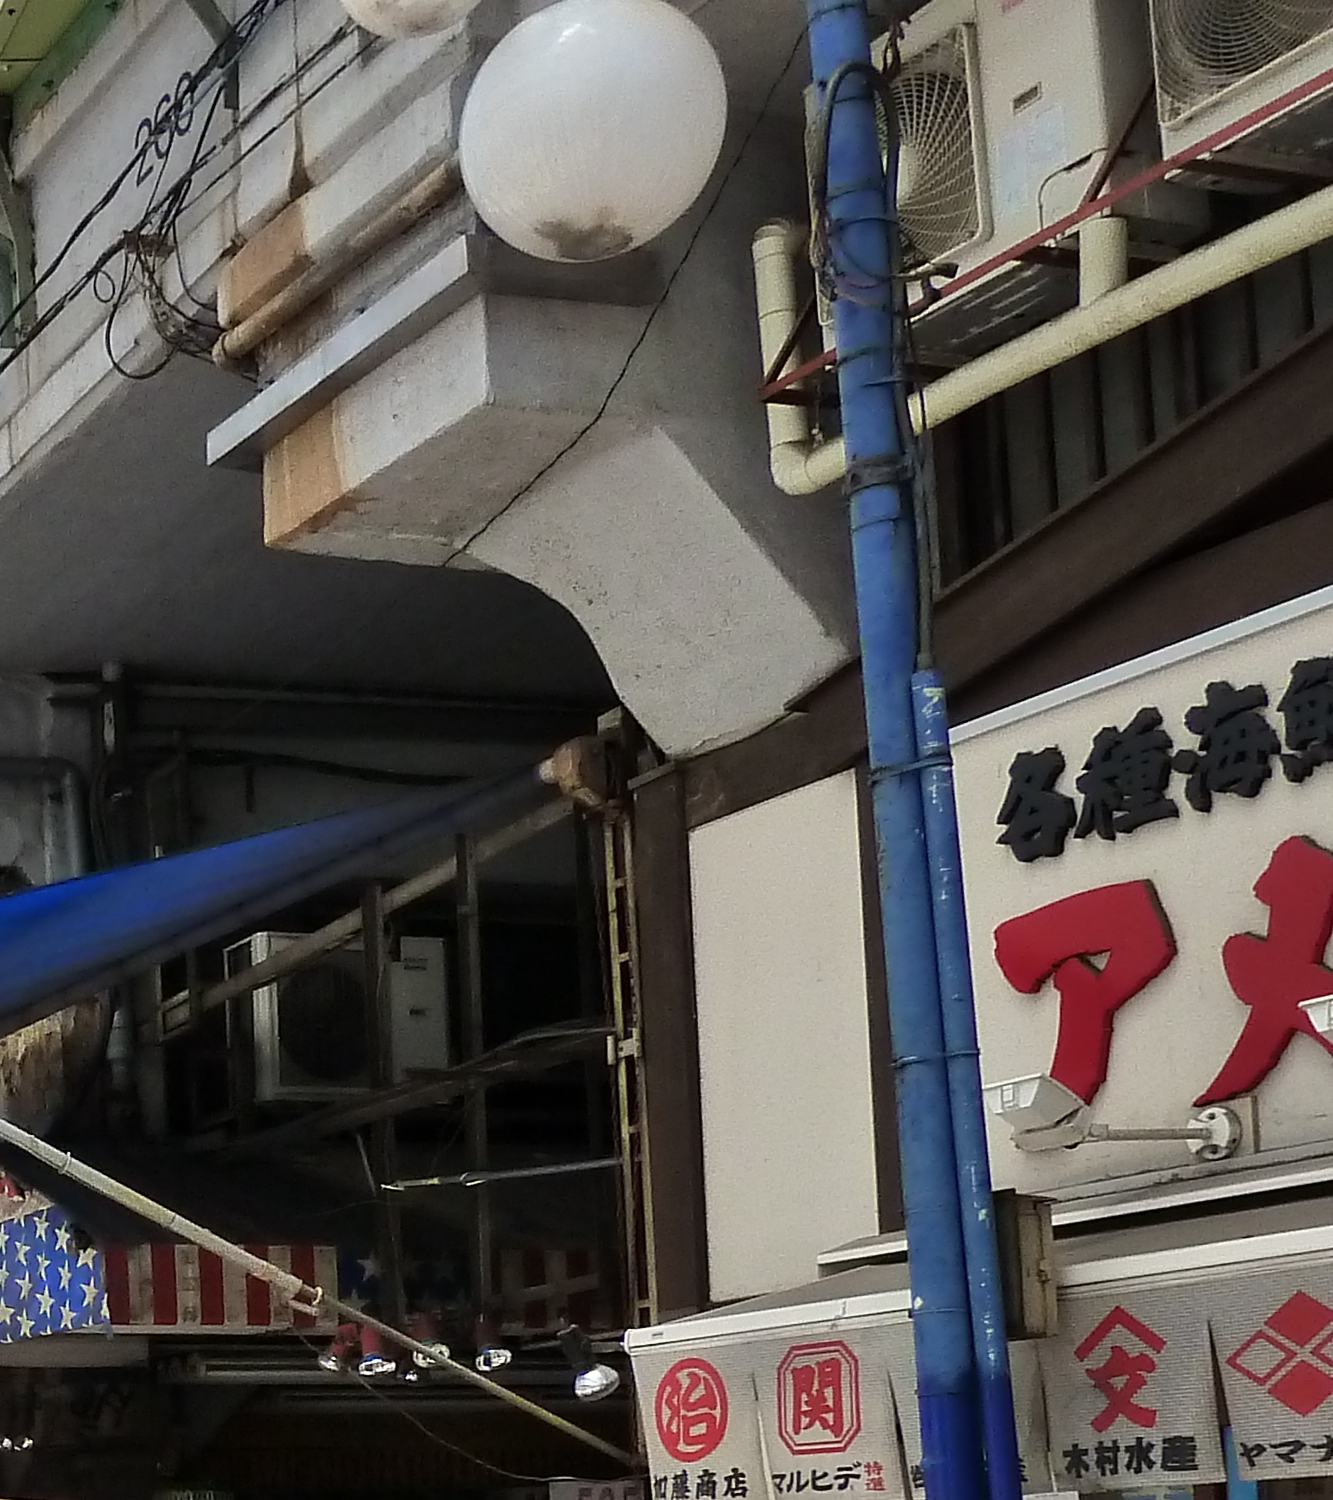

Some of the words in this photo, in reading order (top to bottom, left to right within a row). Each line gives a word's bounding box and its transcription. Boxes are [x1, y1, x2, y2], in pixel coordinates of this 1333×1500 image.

[791, 1357, 836, 1439] 関
[771, 1461, 864, 1495] マルヒデ
[1062, 1434, 1200, 1479] 木村水産
